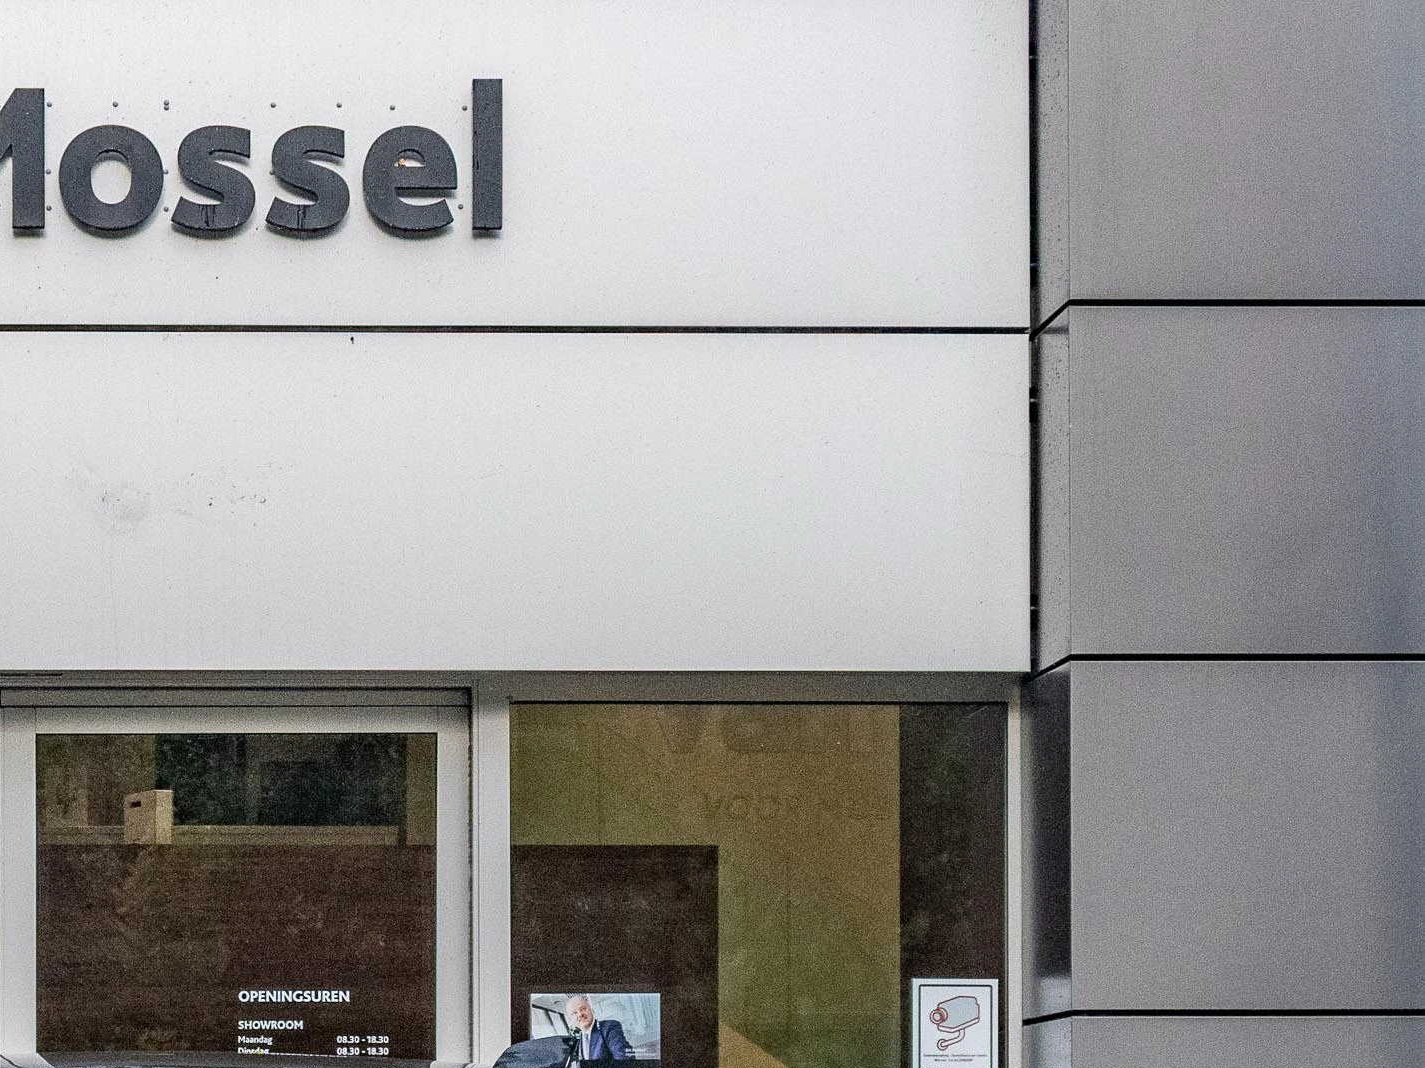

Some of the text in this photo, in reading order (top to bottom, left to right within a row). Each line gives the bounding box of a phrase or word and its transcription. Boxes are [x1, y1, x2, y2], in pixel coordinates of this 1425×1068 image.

[237, 990, 351, 1003] OPENINGSUREN
[237, 1020, 304, 1030] SHOWROOM
[237, 1035, 273, 1045] Maandag
[336, 1035, 360, 1044] 08.30
[366, 1035, 390, 1044] 18.30
[336, 1047, 360, 1056] 08.30
[366, 1047, 390, 1056] 18.30
